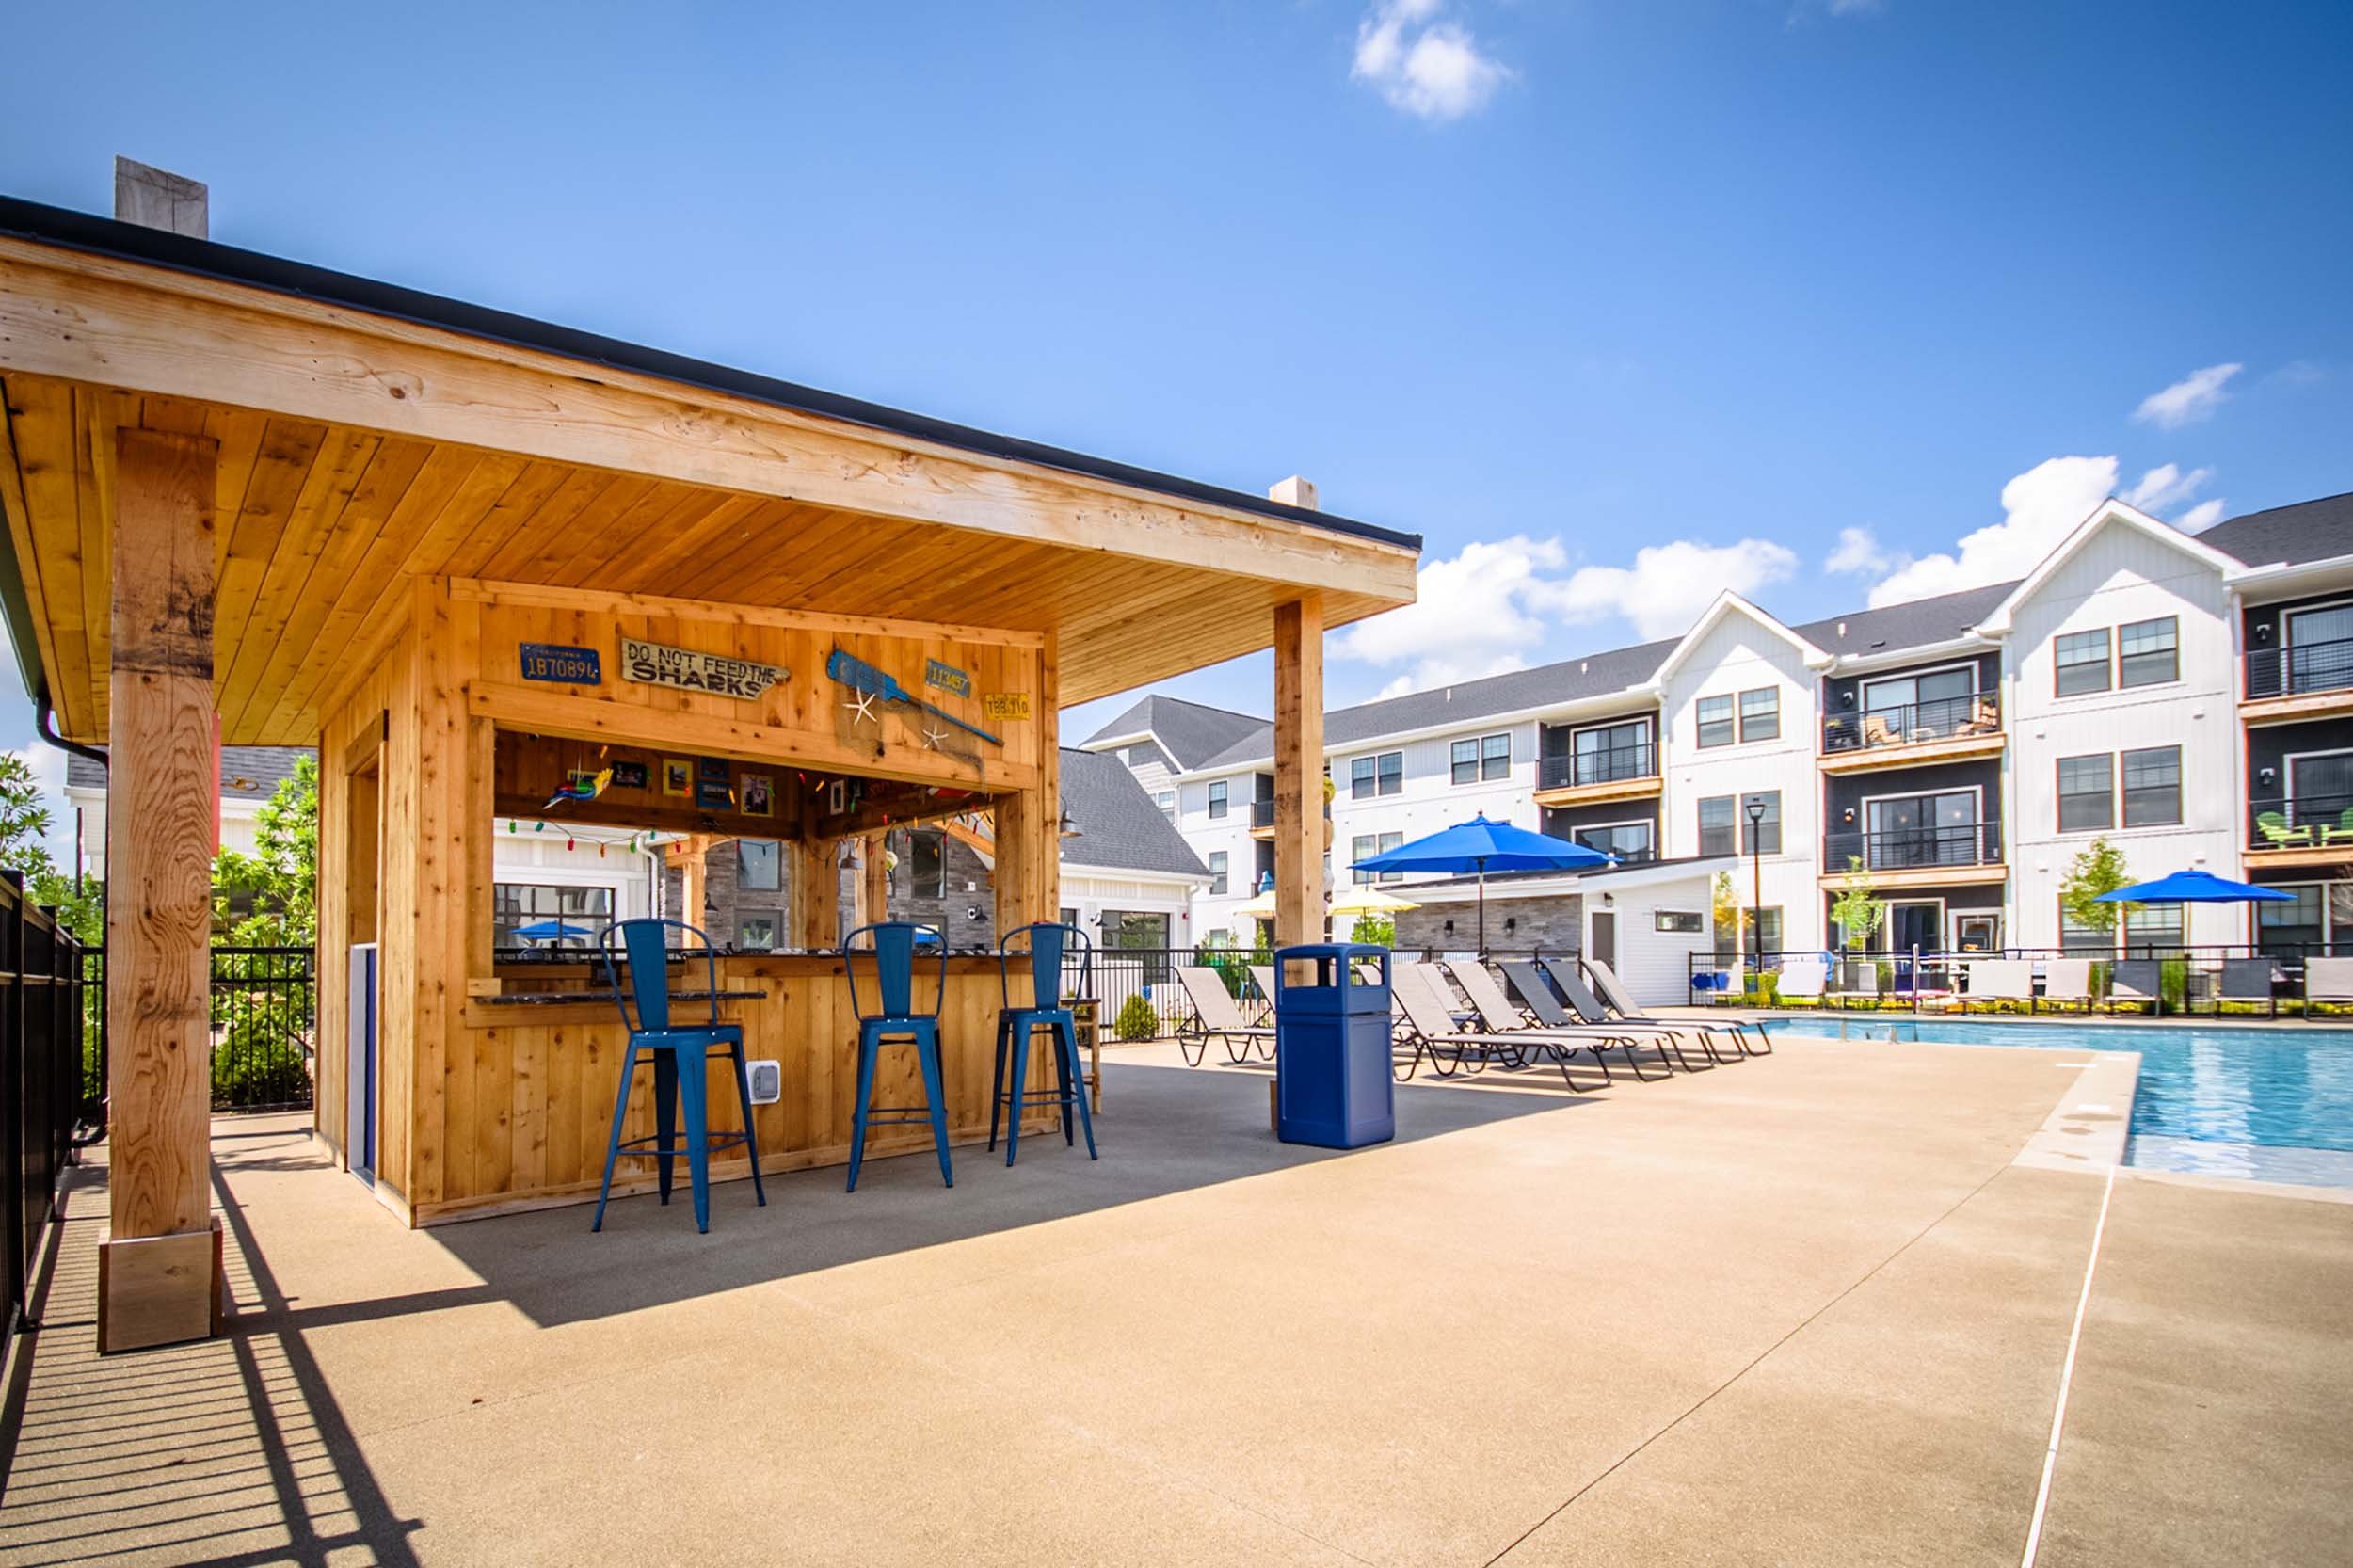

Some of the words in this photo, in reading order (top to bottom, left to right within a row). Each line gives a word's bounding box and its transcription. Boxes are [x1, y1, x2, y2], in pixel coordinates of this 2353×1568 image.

[628, 643, 650, 662] DO
[658, 648, 696, 669] NOT
[704, 657, 747, 678] FEED
[747, 664, 776, 684] THE
[632, 661, 763, 698] SHARKS
